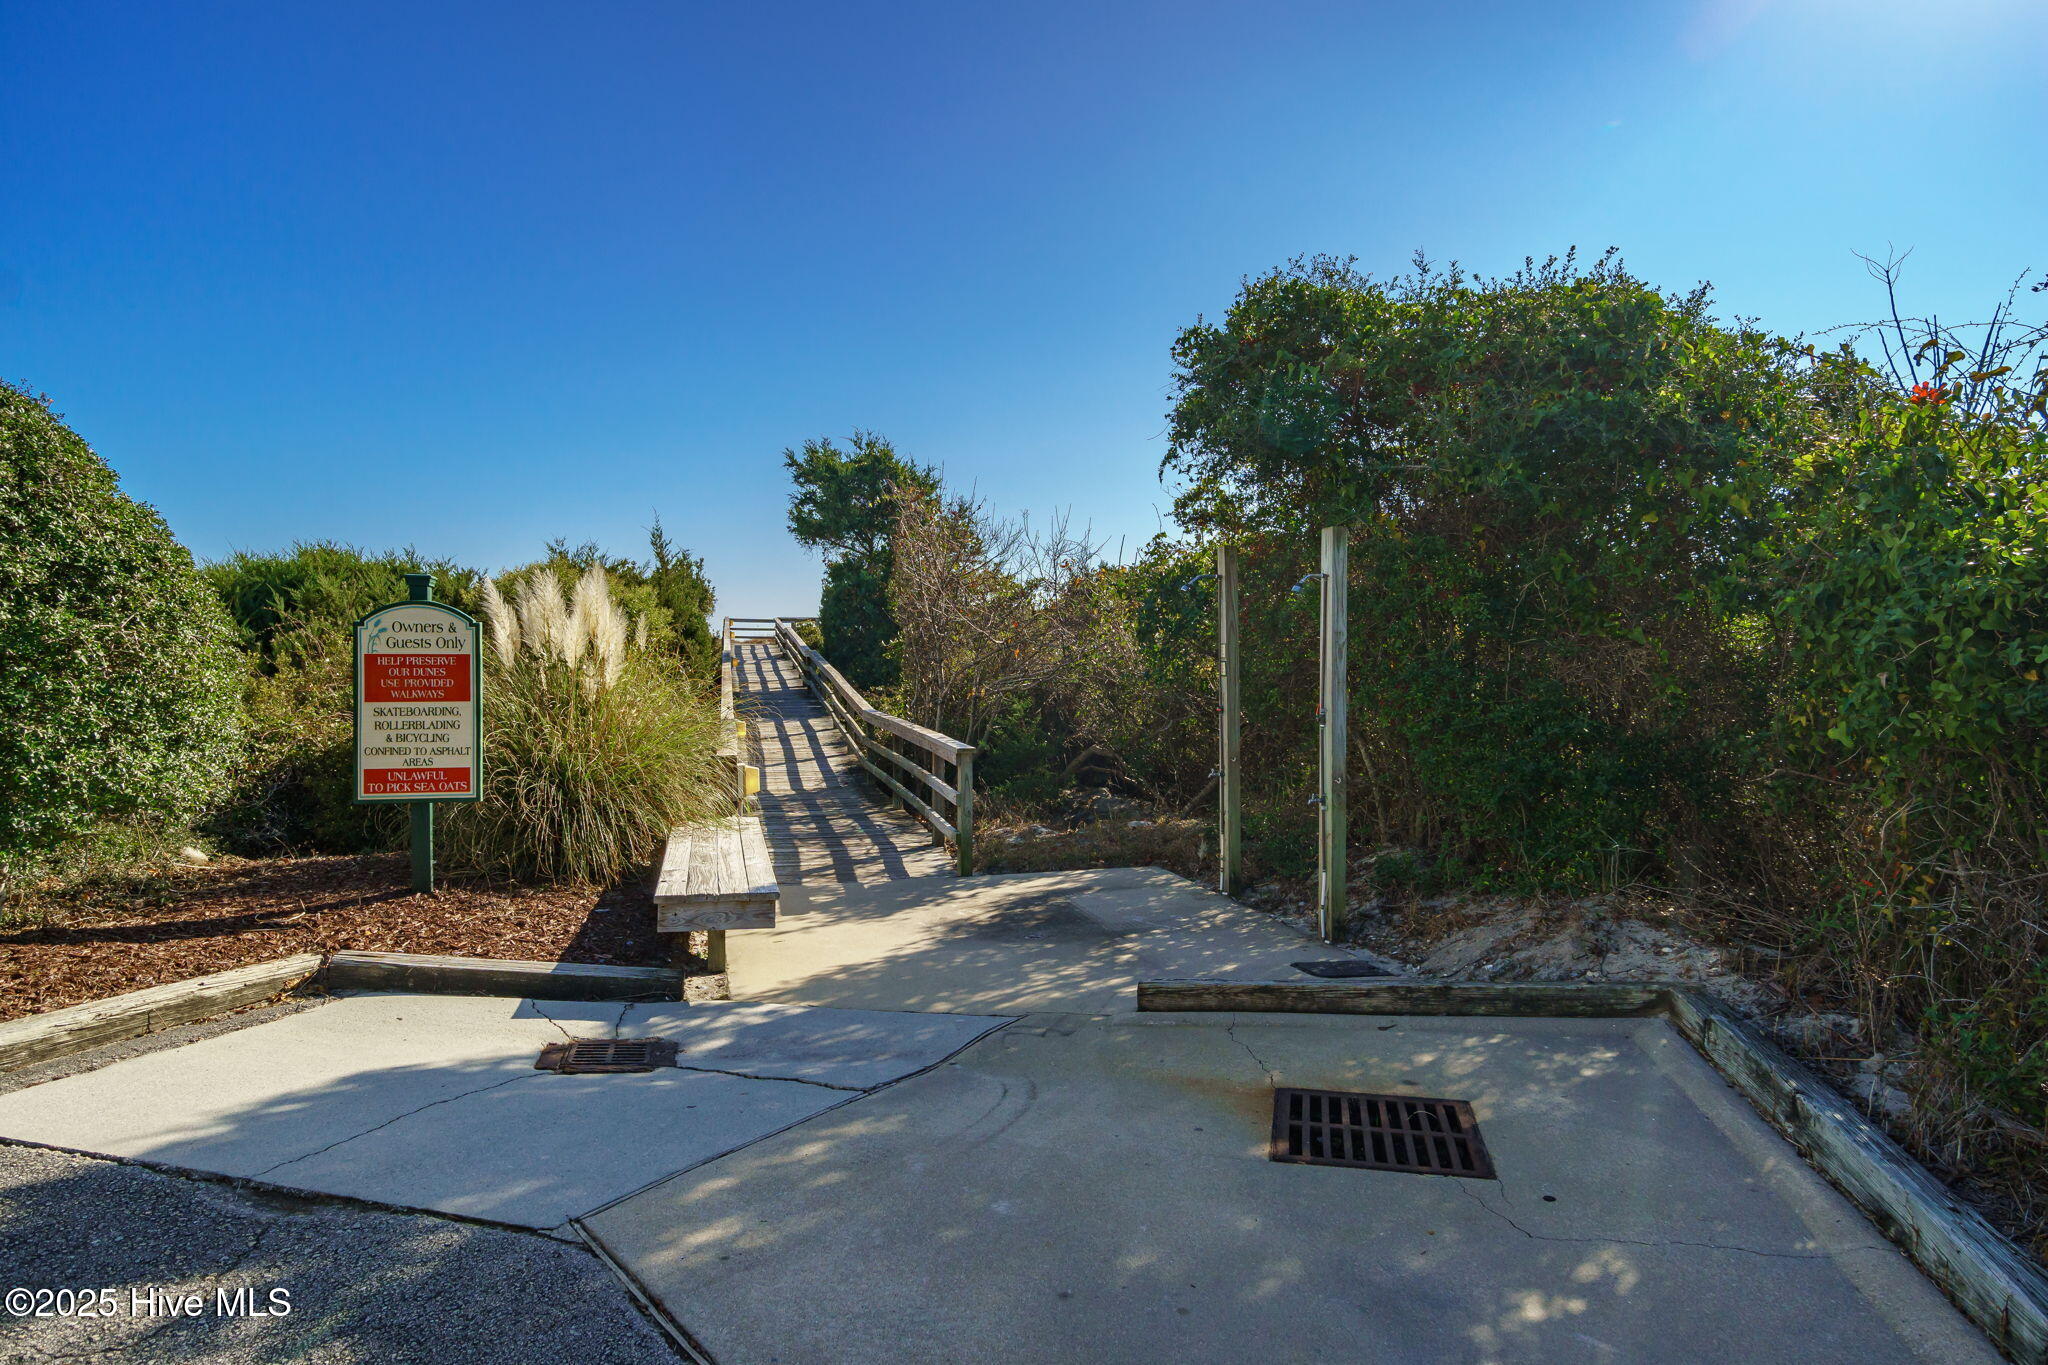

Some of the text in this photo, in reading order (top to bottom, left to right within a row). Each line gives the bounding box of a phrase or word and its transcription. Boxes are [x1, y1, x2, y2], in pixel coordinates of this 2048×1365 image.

[392, 621, 456, 633] Owners &
[386, 636, 466, 651] Guests Only
[377, 657, 456, 665] HELP PRESERVE
[388, 668, 446, 676] OUR DUNES
[380, 679, 454, 687] USE PROVIDED
[391, 690, 444, 698] WALKWAYS
[373, 707, 461, 716] SKATEBOARDING,
[374, 720, 460, 730] ROLLERBLADING
[386, 734, 450, 742] & BICYCLING
[364, 747, 471, 755] CONFINED TO ASPHALT
[402, 757, 433, 766] AREAS
[388, 771, 447, 781] UNLAWFUL
[368, 781, 467, 792] TO PICK SEA OATS
